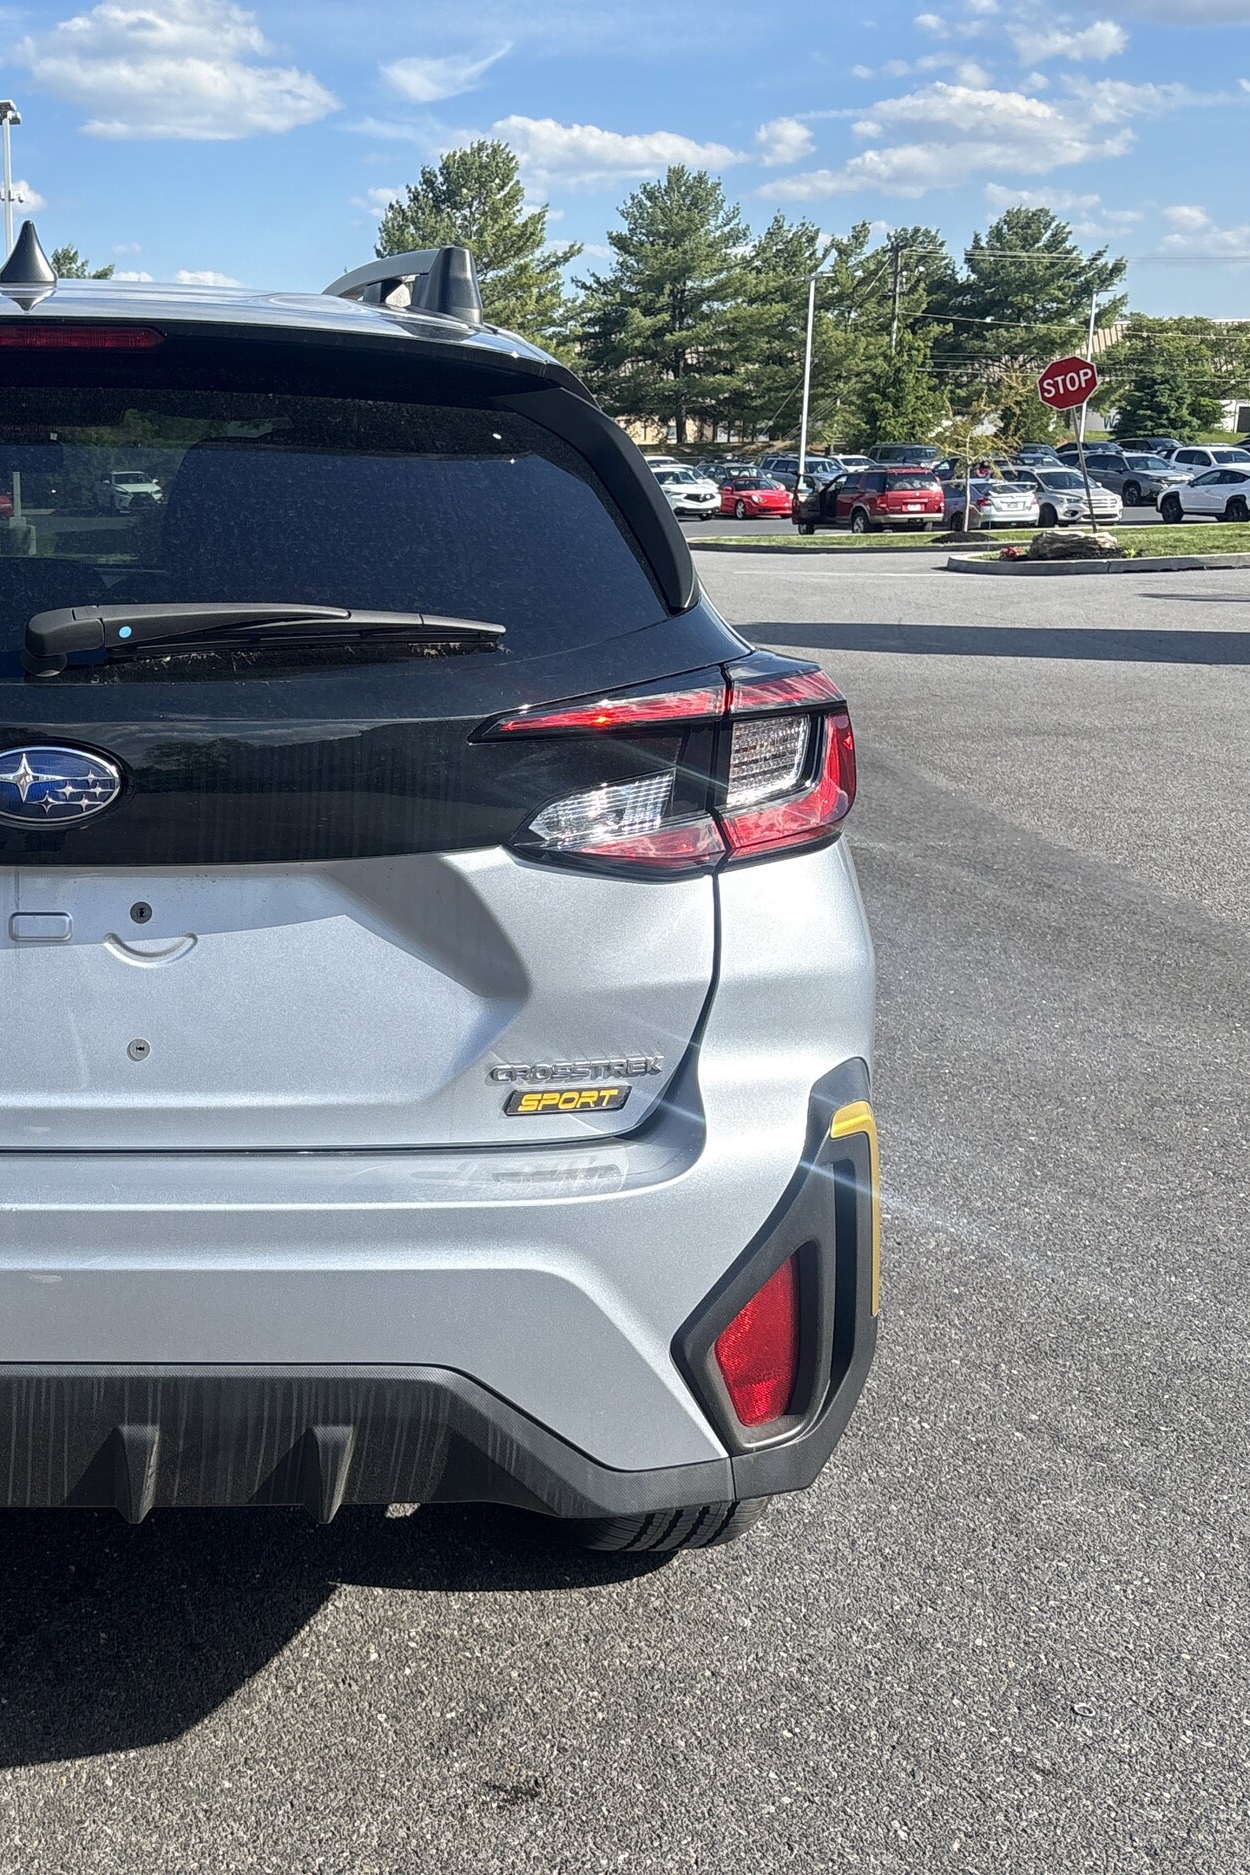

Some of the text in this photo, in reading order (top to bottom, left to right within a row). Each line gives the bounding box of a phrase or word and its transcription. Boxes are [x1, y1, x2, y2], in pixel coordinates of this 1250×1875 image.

[1042, 368, 1093, 398] STOP
[490, 1055, 665, 1083] CROSSTREK
[517, 1088, 619, 1112] SPORT
